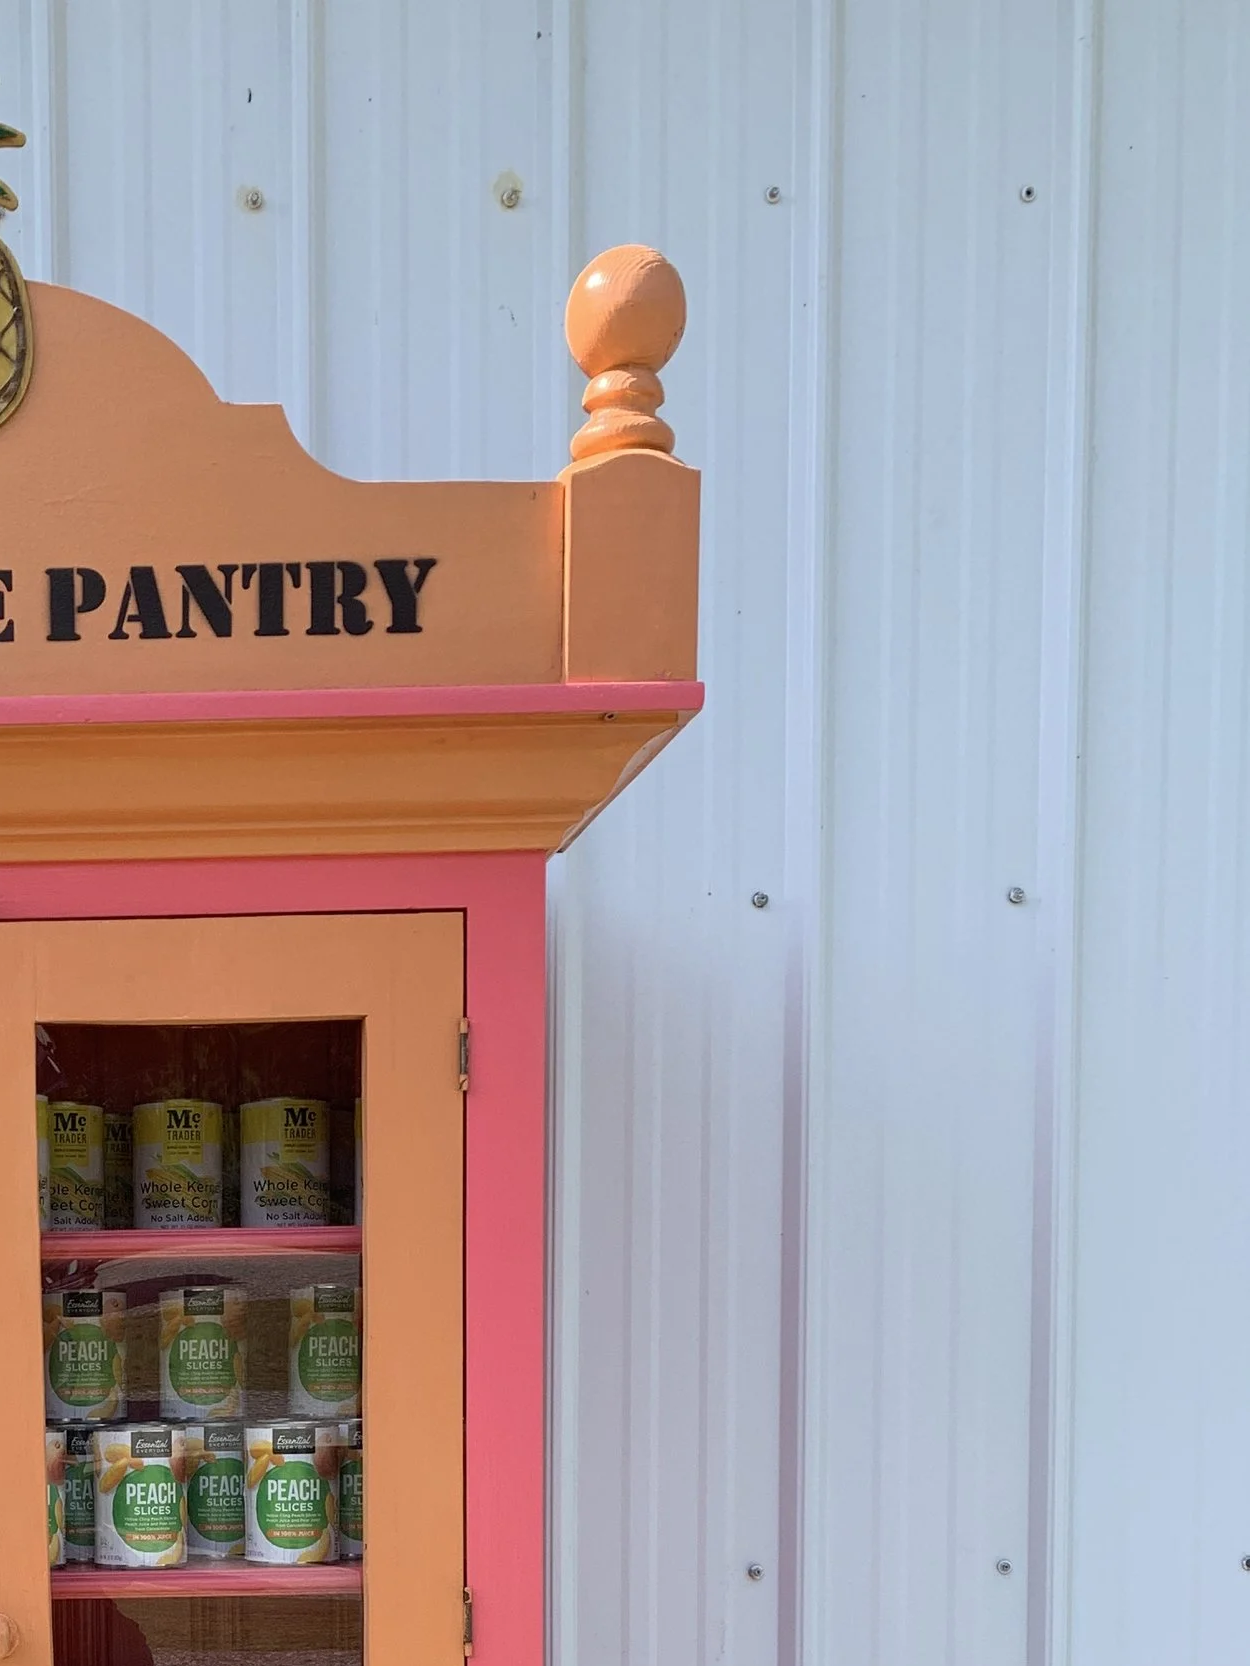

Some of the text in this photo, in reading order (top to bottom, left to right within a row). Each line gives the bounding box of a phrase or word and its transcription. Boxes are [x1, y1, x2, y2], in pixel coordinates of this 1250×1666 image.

[44, 557, 438, 642] PANTRY
[54, 1133, 87, 1144] TRADER
[167, 1131, 200, 1141] TRADER
[284, 1129, 316, 1139] TRADER
[141, 1181, 182, 1193] Whole
[254, 1180, 298, 1192] Whole
[145, 1198, 186, 1209] Sweet
[258, 1196, 302, 1207] Sweet
[54, 1216, 71, 1225] Salt
[151, 1215, 163, 1223] No
[166, 1214, 183, 1222] Salt
[266, 1212, 300, 1220] No Salt
[59, 1340, 108, 1362] PEACH
[179, 1339, 229, 1360] PEACH
[309, 1336, 359, 1357] PEACH
[65, 1363, 102, 1372] SLICES
[186, 1361, 223, 1370] SLICES
[315, 1358, 352, 1367] SLICES
[208, 1432, 241, 1444] Essential
[276, 1435, 312, 1446] Essential
[135, 1438, 168, 1450] Essential
[65, 1480, 93, 1501] PEA
[126, 1483, 177, 1506] PEACH
[267, 1479, 320, 1501] PEACH
[70, 1502, 93, 1511] SLIC
[206, 1498, 244, 1508] SLICES
[274, 1502, 313, 1512] SLICES
[133, 1506, 171, 1516] SLICES
